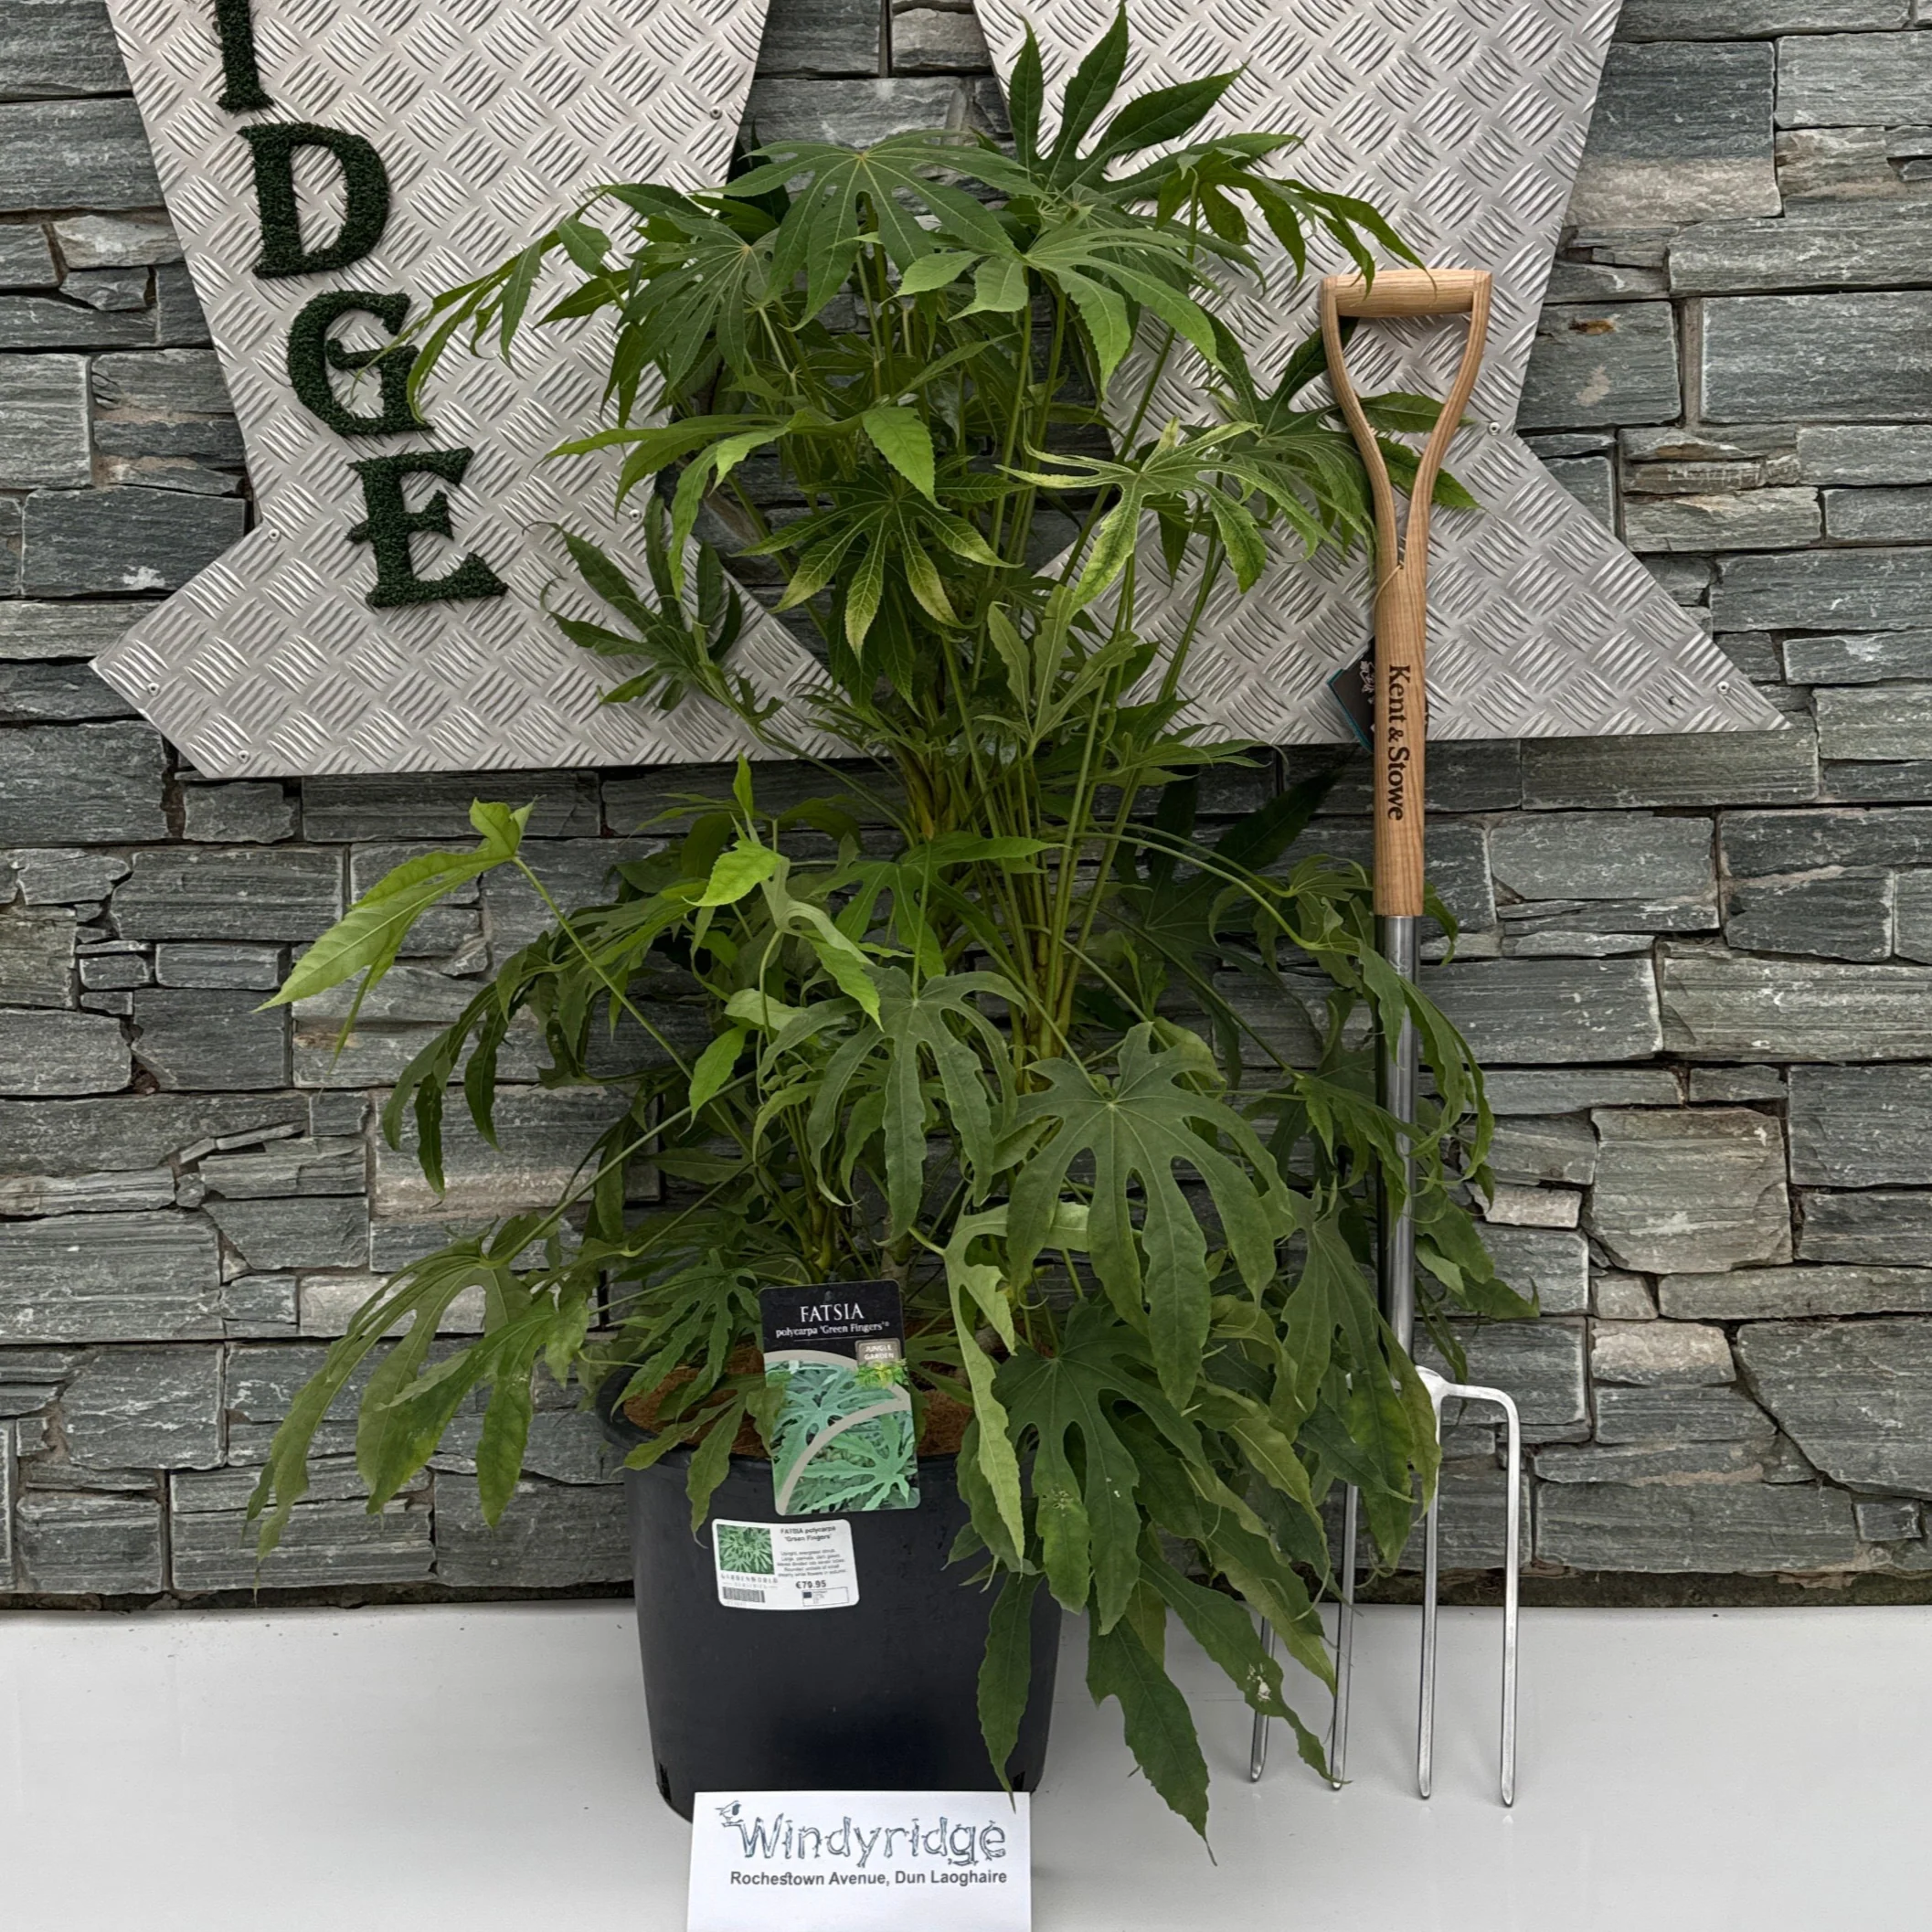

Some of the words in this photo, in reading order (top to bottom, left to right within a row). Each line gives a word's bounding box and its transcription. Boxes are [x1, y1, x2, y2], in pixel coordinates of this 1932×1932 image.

[1388, 664, 1410, 724] Kent
[1388, 727, 1404, 743] &
[1387, 746, 1409, 821] Stowe
[800, 1302, 865, 1322] FATSIA
[775, 1327, 818, 1339] polycarpa
[865, 1343, 892, 1352] JUNGLE
[864, 1353, 895, 1361] GARDEN
[722, 1812, 1007, 1867] Windyridge
[730, 1870, 824, 1885] Rochestown
[828, 1871, 890, 1886] Avenue,
[895, 1869, 926, 1884] Dun
[930, 1870, 1008, 1886] Laoghaire
